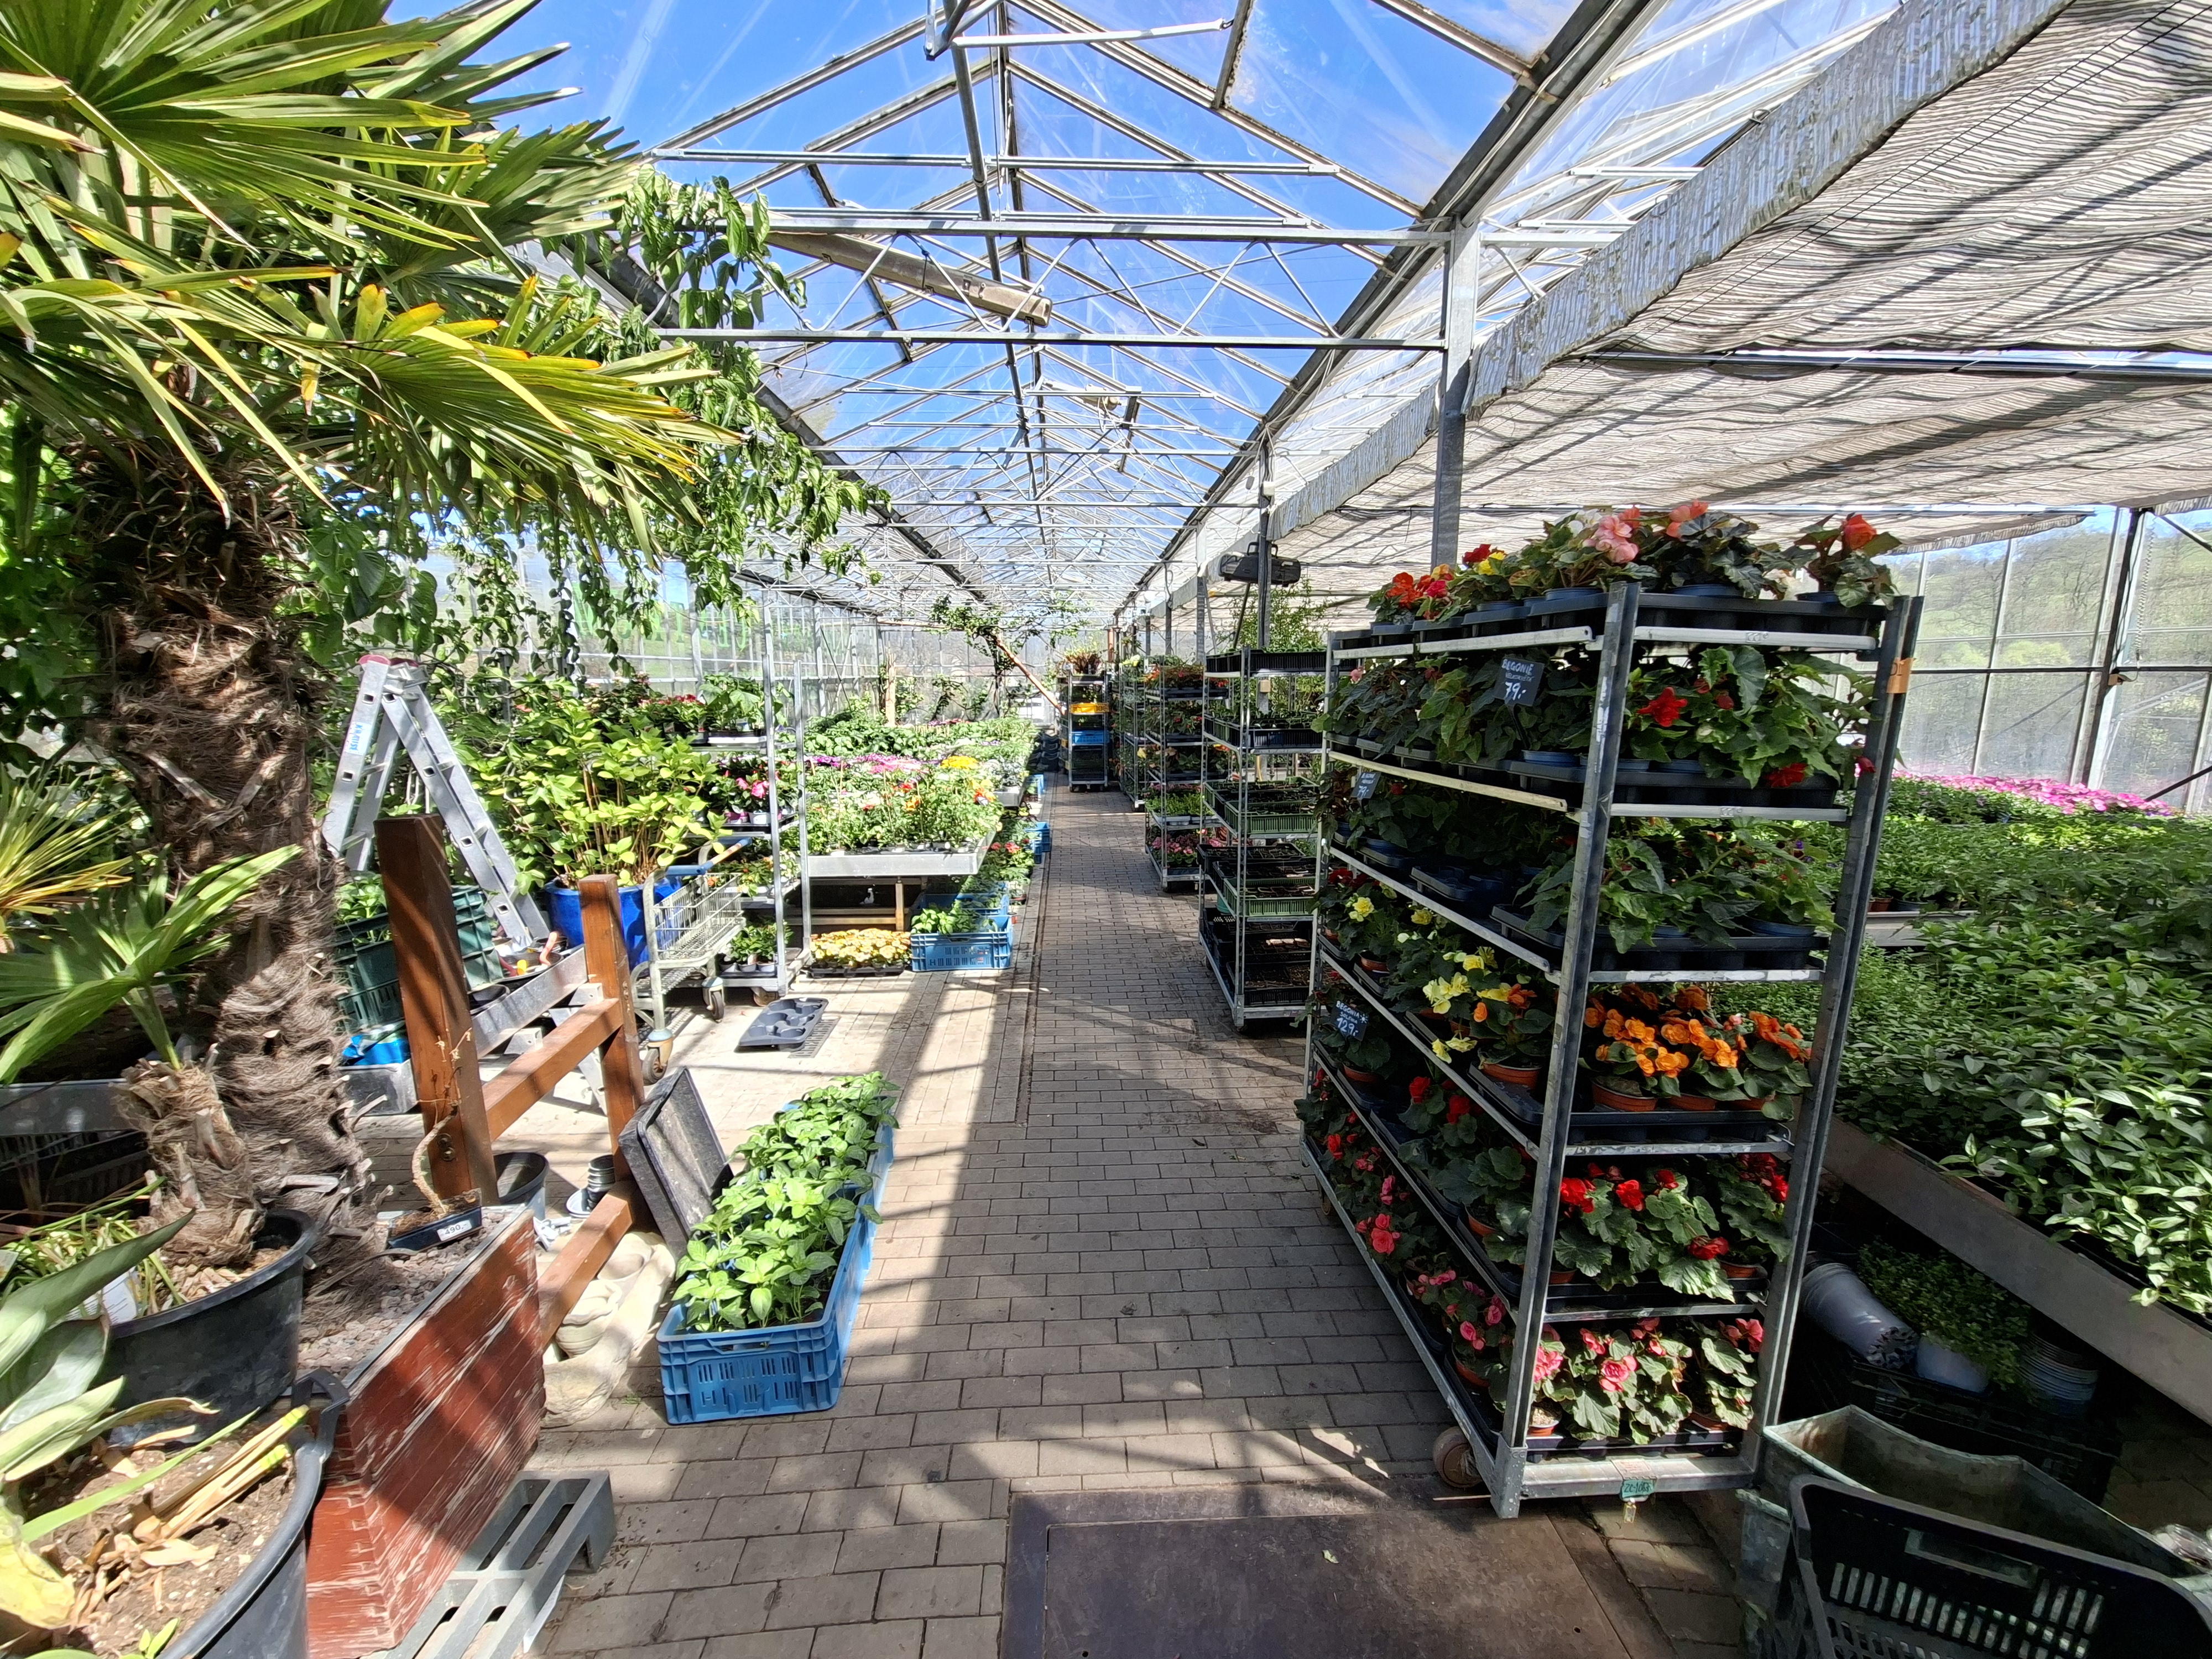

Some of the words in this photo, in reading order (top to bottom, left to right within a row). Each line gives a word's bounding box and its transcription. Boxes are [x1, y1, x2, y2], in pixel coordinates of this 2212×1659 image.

[1501, 658, 1535, 676] BEGONIE
[1335, 1000, 1360, 1019] BEGONIA
[445, 1224, 467, 1235] 490,-
